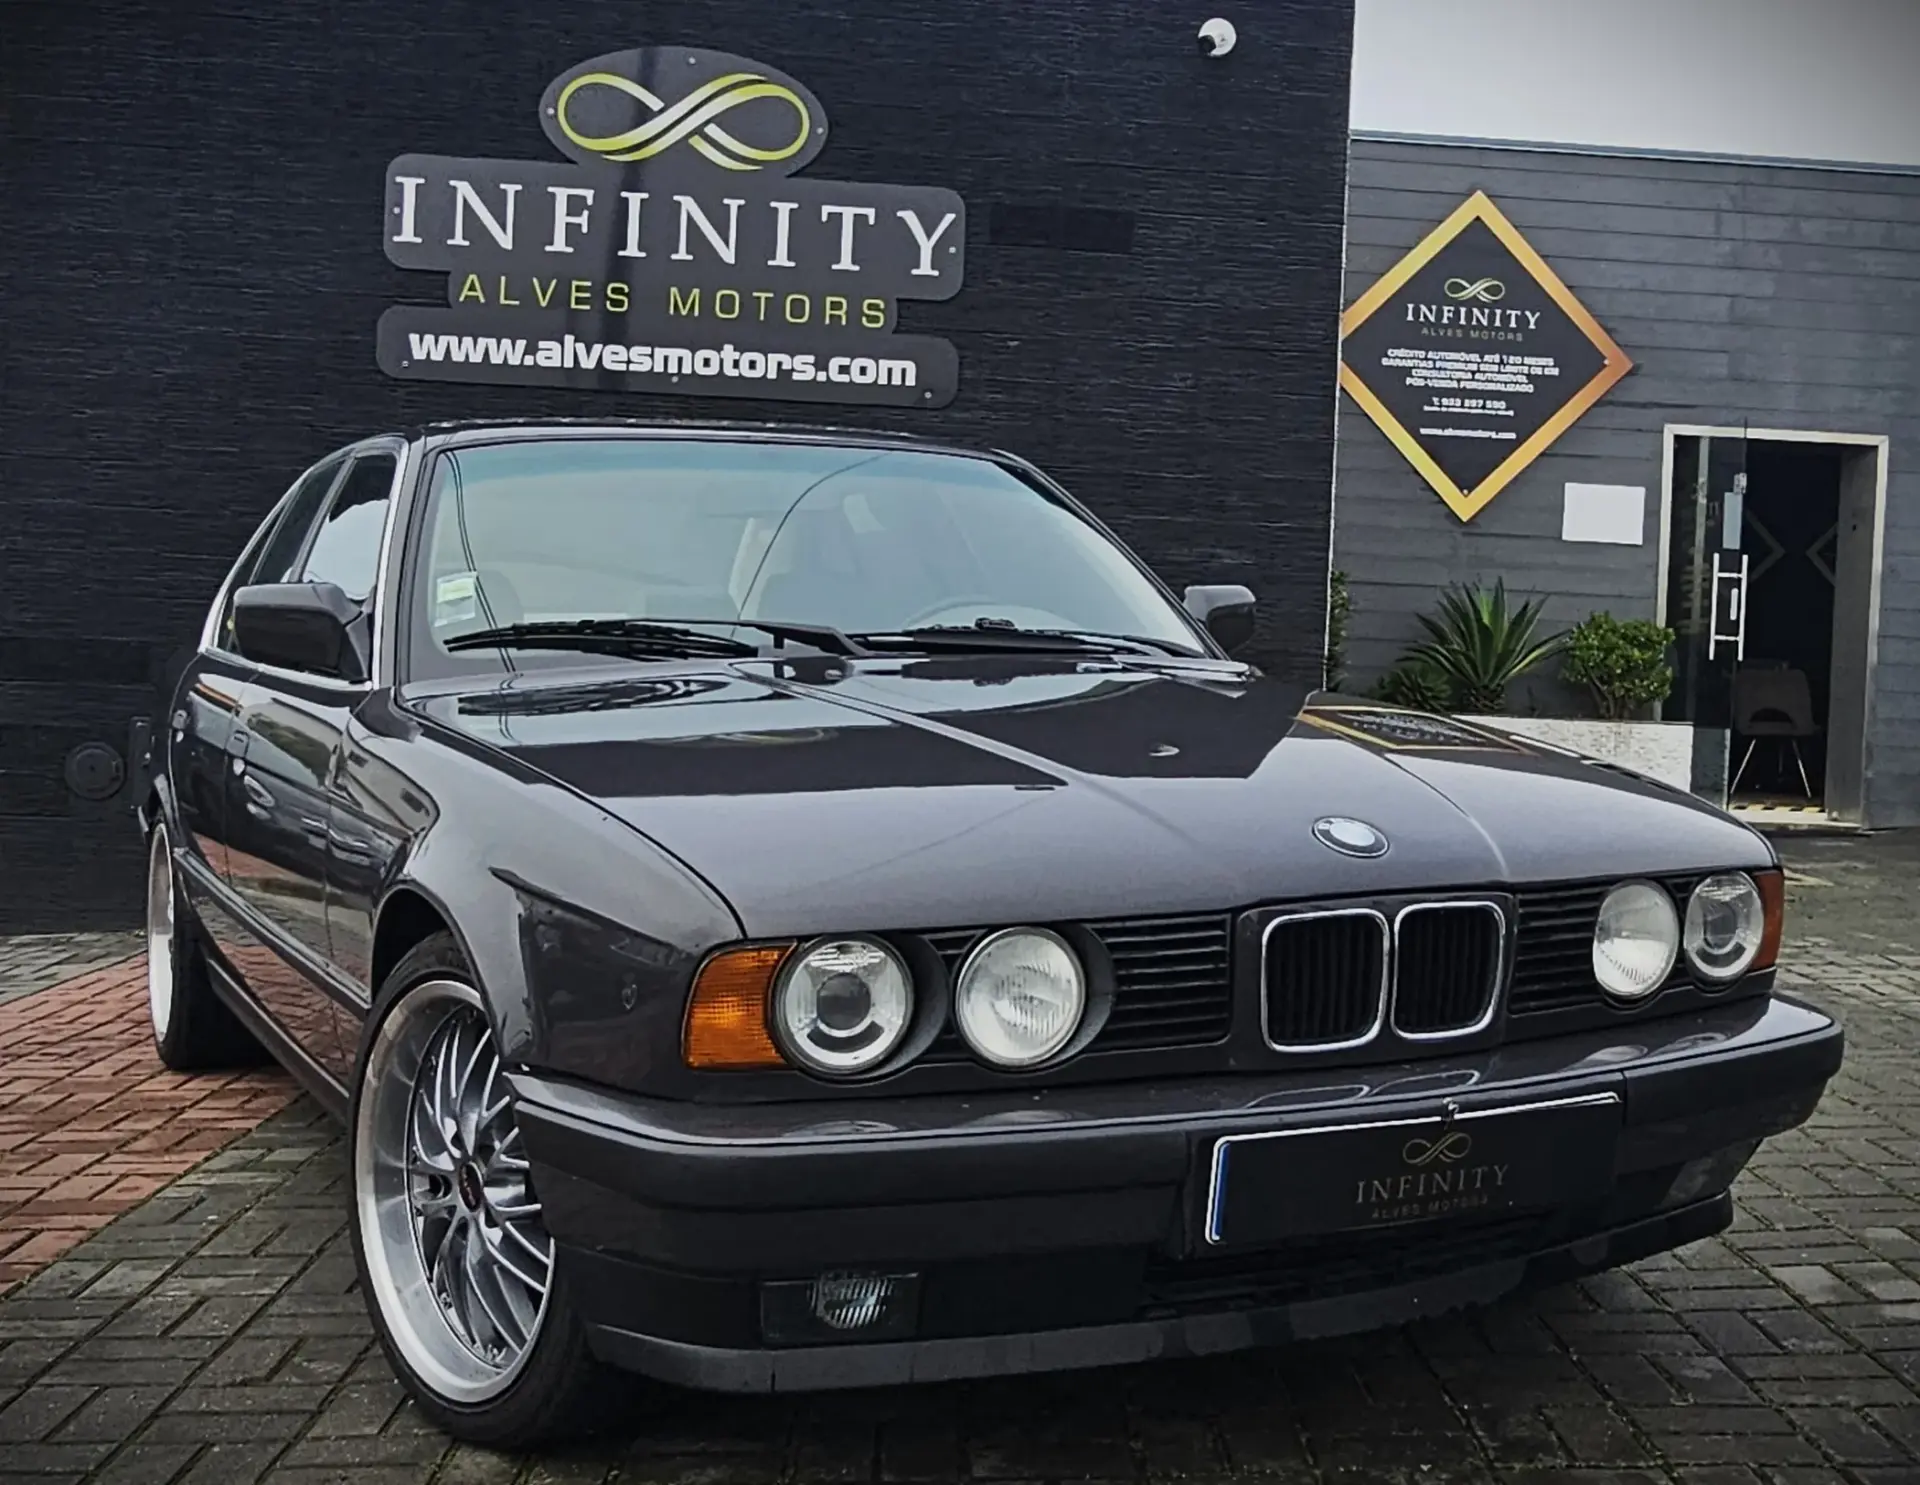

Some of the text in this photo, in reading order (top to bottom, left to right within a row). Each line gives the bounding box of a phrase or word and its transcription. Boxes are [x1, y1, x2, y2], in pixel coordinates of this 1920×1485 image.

[392, 176, 956, 277] INFINITY
[459, 273, 886, 329] ALVES MOTORS
[1406, 303, 1540, 329] INFINITY
[1421, 327, 1523, 342] ALVES MOTORS
[408, 331, 917, 387] www.alvesmotors.com
[1355, 1164, 1509, 1204] INFINITY
